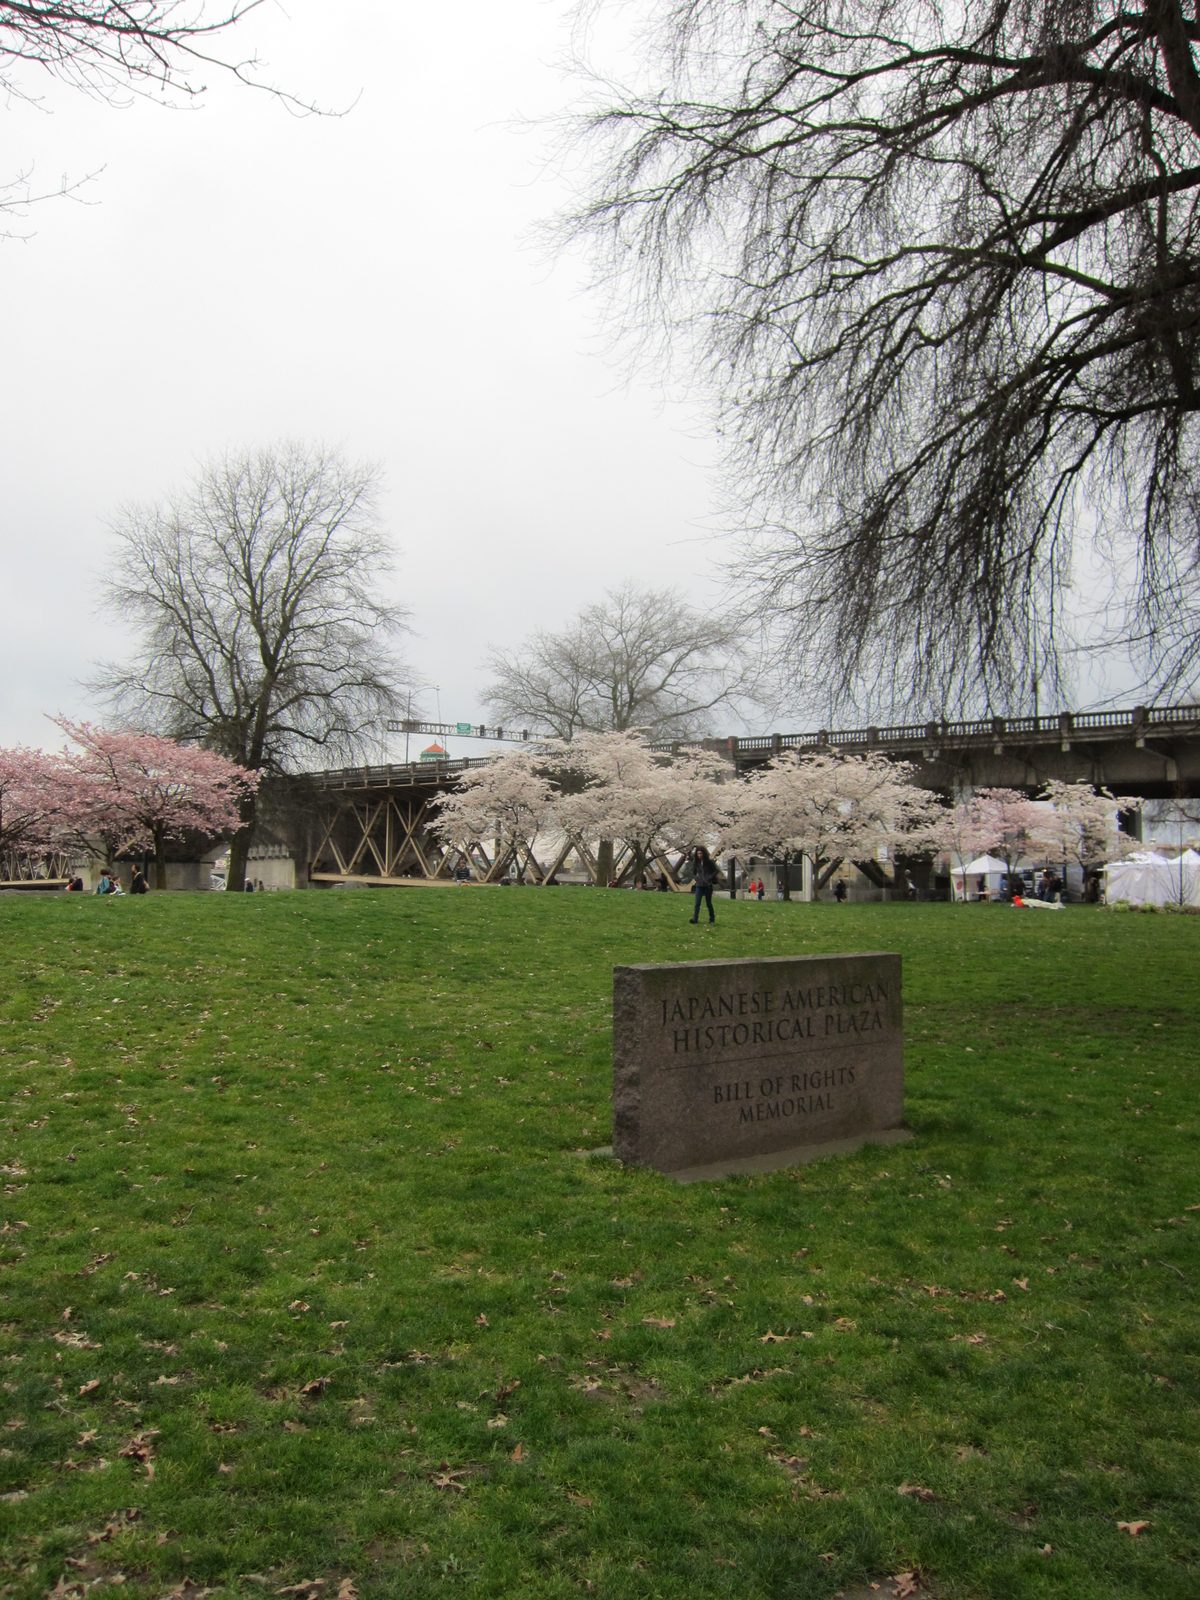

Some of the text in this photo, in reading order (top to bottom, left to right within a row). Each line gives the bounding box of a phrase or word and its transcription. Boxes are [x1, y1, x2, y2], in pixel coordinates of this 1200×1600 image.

[661, 983, 890, 1027] JAPANESE AMERICAN
[672, 1010, 883, 1053] HISTORICAL PLAZA
[713, 1067, 856, 1105] BILL OF RIGHTS
[738, 1093, 835, 1125] MEMORIAL
